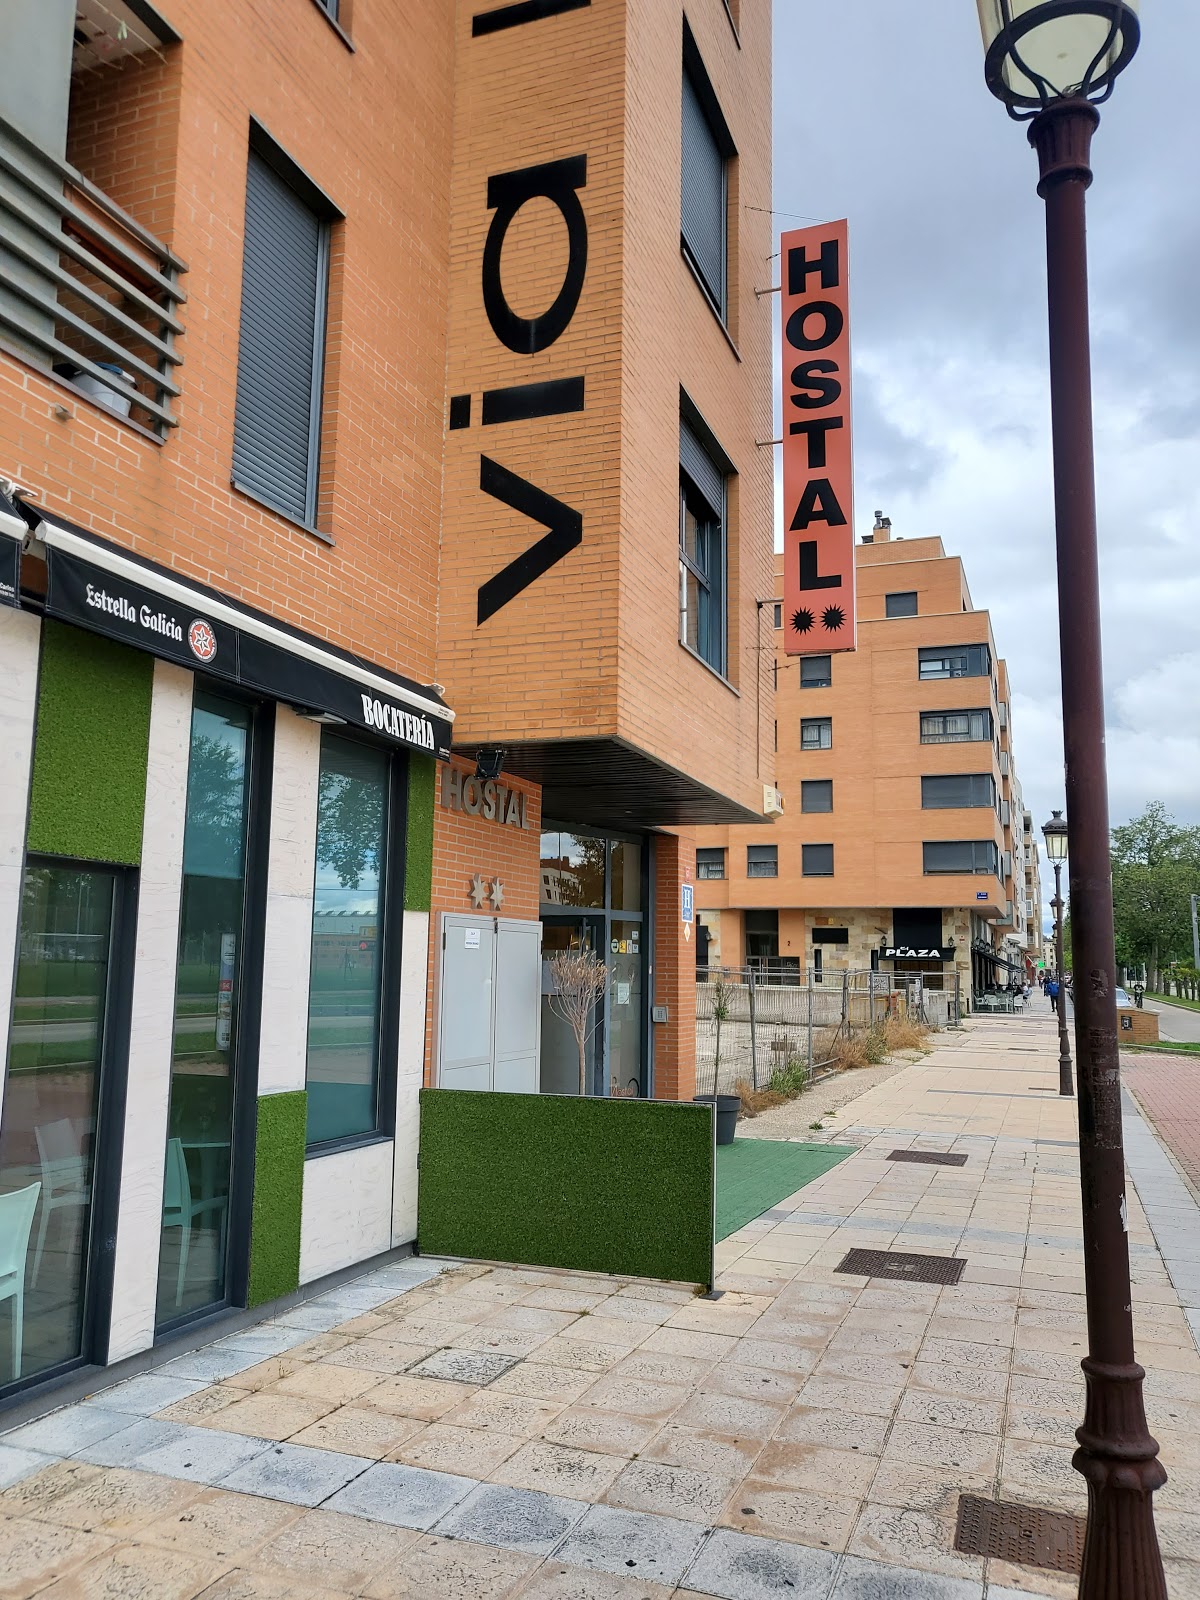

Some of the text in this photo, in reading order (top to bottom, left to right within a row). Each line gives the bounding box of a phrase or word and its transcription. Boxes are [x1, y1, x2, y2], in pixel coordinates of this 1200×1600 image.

[450, 154, 587, 626] via
[785, 239, 848, 592] HOSTAL
[85, 583, 137, 623] Estrella
[139, 605, 183, 642] Galicia
[360, 693, 435, 751] BOCATERÍA
[441, 766, 530, 830] HOSTAL
[885, 948, 941, 958] PLAZA
